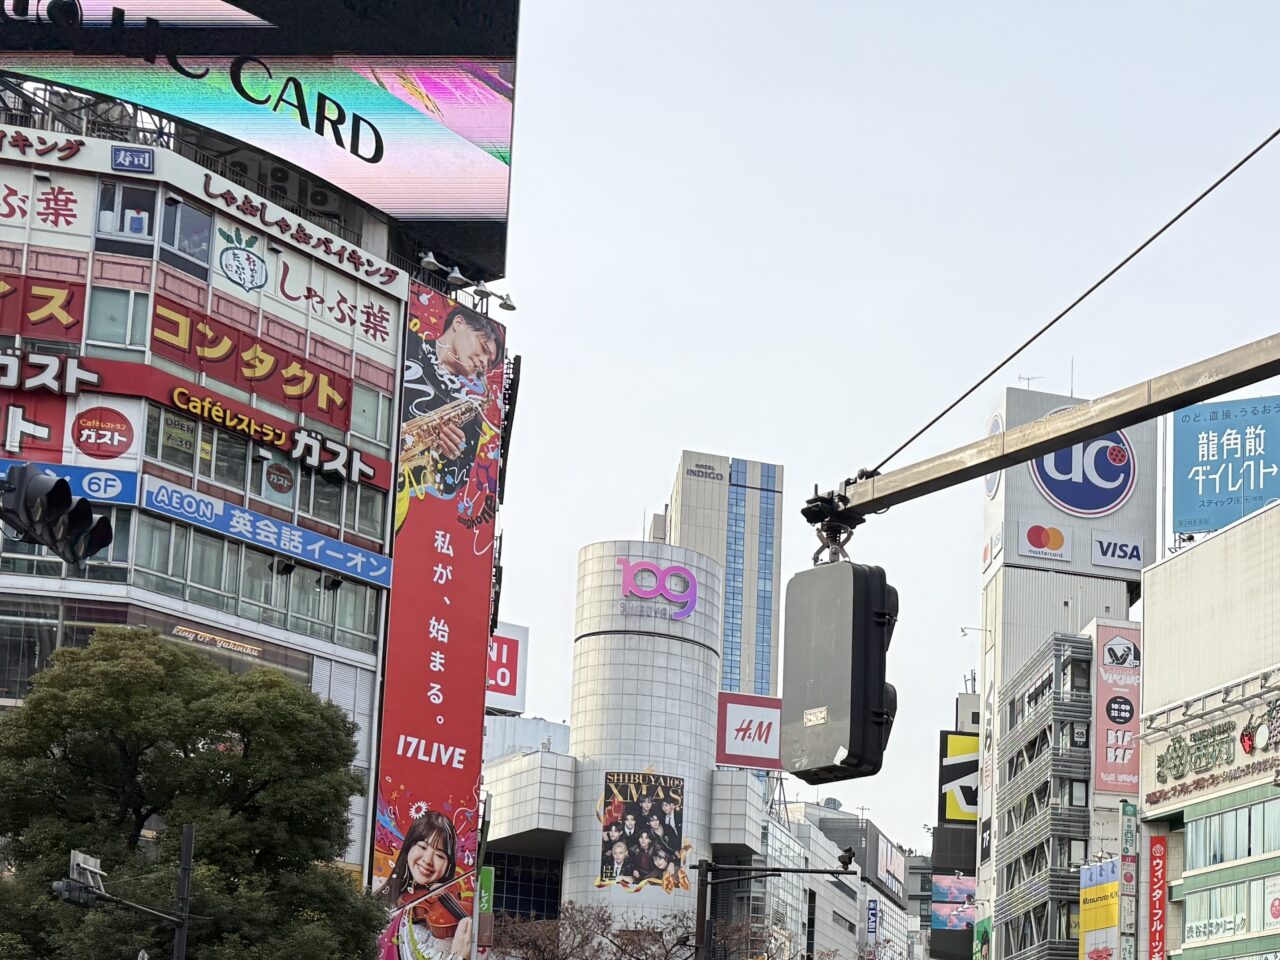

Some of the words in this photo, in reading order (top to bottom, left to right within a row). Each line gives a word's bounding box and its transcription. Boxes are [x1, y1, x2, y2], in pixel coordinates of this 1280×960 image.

[230, 56, 384, 165] CARD
[114, 148, 152, 171] 寿司
[203, 173, 399, 286] しゃぶしゃぶバイキング
[0, 281, 78, 328] ス
[279, 260, 391, 342] しゃぶ葉
[153, 304, 344, 409] コンタクト
[78, 429, 128, 447] ガスト
[165, 417, 194, 434] OPEN
[292, 430, 374, 483] ガスト
[1198, 425, 1265, 461] 龍角散
[88, 476, 117, 494] 6F
[686, 468, 724, 481] INDIGO
[1188, 460, 1278, 495] ダイレクト
[1199, 497, 1233, 508] スティック
[155, 487, 215, 521] AEON
[229, 509, 388, 577] 英会話イーオン
[1028, 549, 1063, 558] mastercard
[1096, 540, 1141, 561] VISA
[616, 557, 698, 620] 109
[427, 530, 454, 725] 私が、始まる。
[734, 718, 773, 744] H&M
[606, 773, 684, 790] SHIBUYA109
[606, 782, 684, 809] XMAS
[1083, 894, 1110, 905] Matsumoto
